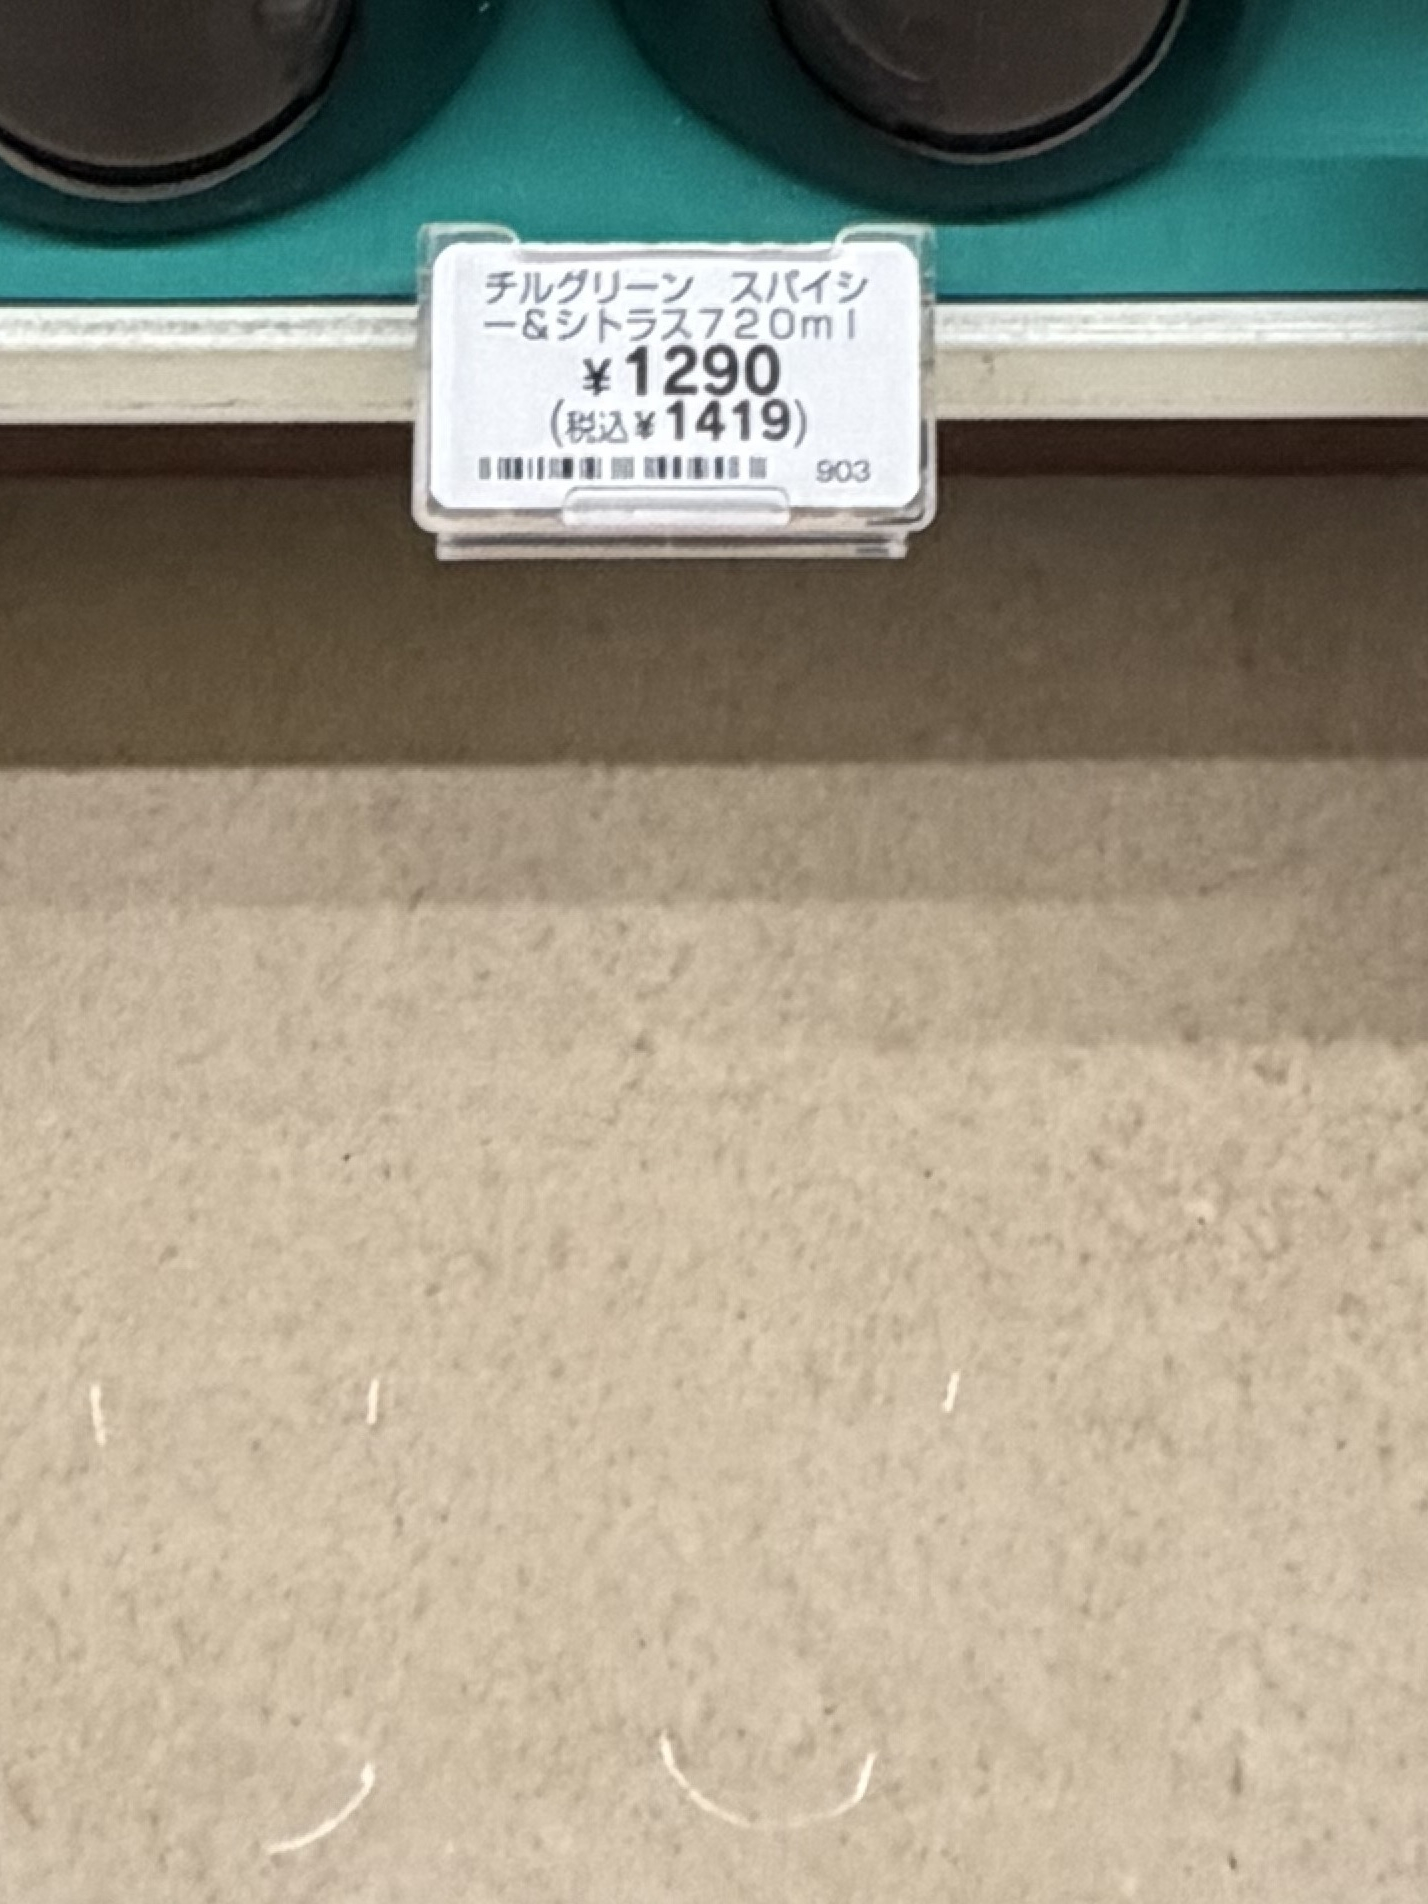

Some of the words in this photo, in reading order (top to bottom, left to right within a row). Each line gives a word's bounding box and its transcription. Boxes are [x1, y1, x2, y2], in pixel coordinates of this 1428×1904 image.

[483, 269, 695, 307] チルグリーン
[730, 268, 870, 305] スパイシ
[584, 342, 781, 397] ¥1290
[815, 458, 872, 484] 903
